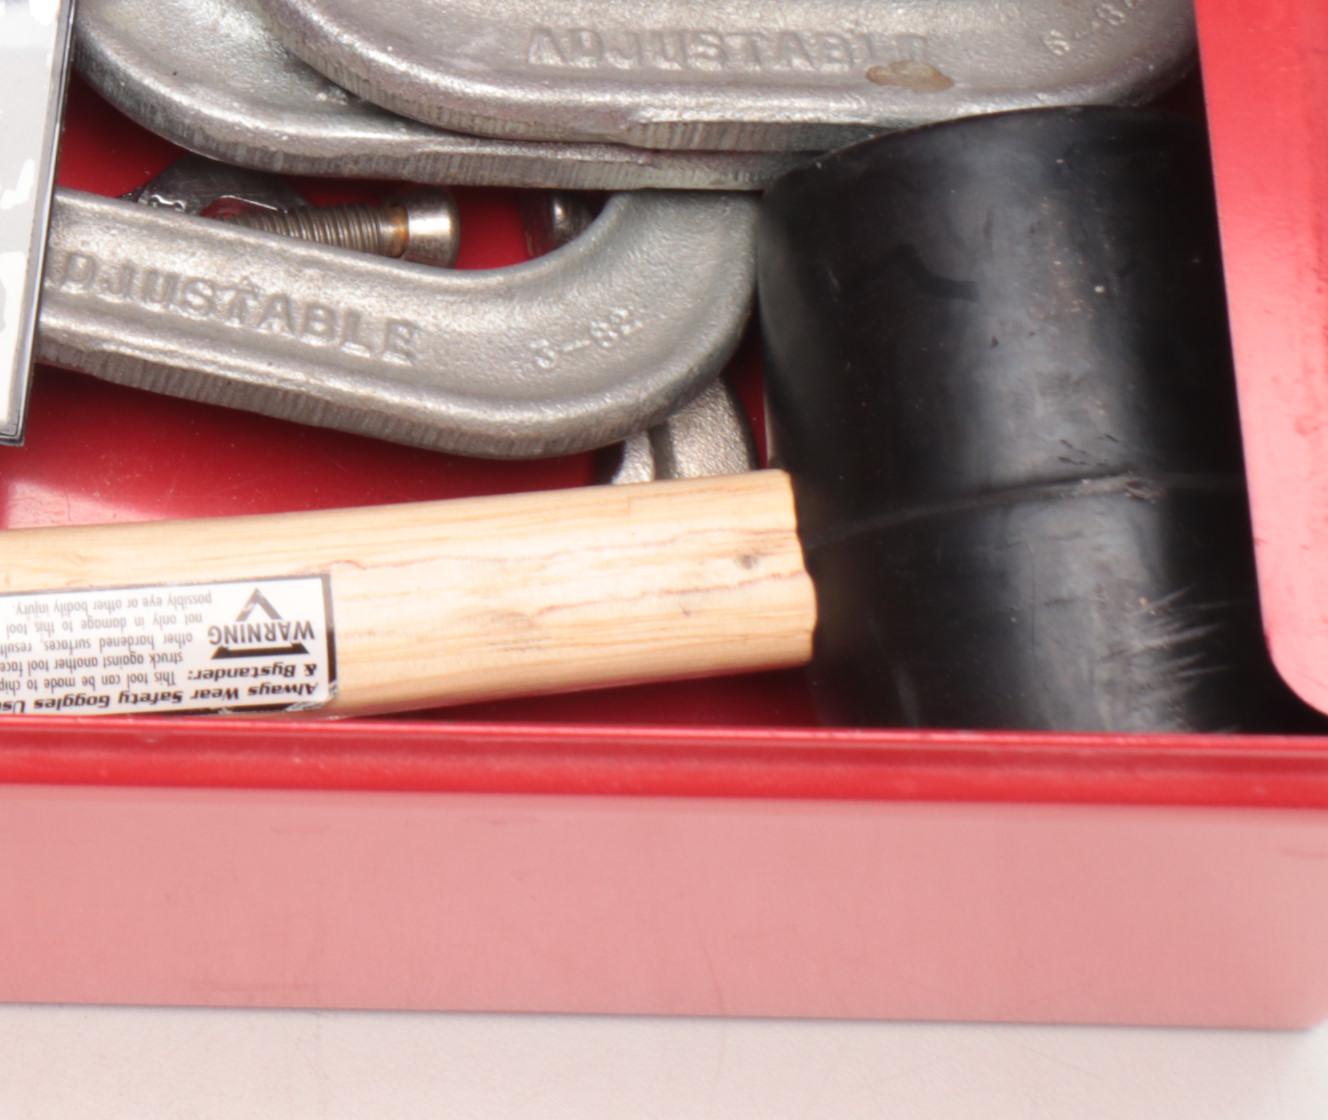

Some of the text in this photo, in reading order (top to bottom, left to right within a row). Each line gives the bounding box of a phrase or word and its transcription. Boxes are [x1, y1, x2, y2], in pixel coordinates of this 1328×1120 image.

[44, 248, 425, 365] DJUSTABLE
[11, 590, 212, 620] possibly eye or other bodily injury.
[62, 621, 73, 632] to
[80, 616, 127, 633] damage
[134, 616, 145, 630] in
[152, 612, 177, 631] only
[184, 613, 202, 626] not
[6, 623, 28, 639] tool
[34, 621, 54, 638] this
[207, 620, 316, 646] WARNING
[99, 635, 154, 654] hardened
[163, 632, 192, 650] other
[27, 660, 49, 677] tool
[54, 656, 98, 674] another
[103, 651, 144, 670] against
[149, 652, 183, 670] struck
[0, 661, 23, 678] face
[186, 662, 318, 682] & Bystander:
[26, 679, 38, 693] to
[44, 677, 75, 694] made
[81, 675, 96, 693] be
[100, 674, 121, 686] can
[126, 672, 148, 689] tool
[153, 672, 176, 688] This
[117, 690, 184, 705] Safety
[190, 687, 239, 701] Wear
[247, 682, 319, 696] Always
[34, 694, 111, 711] Goggles
